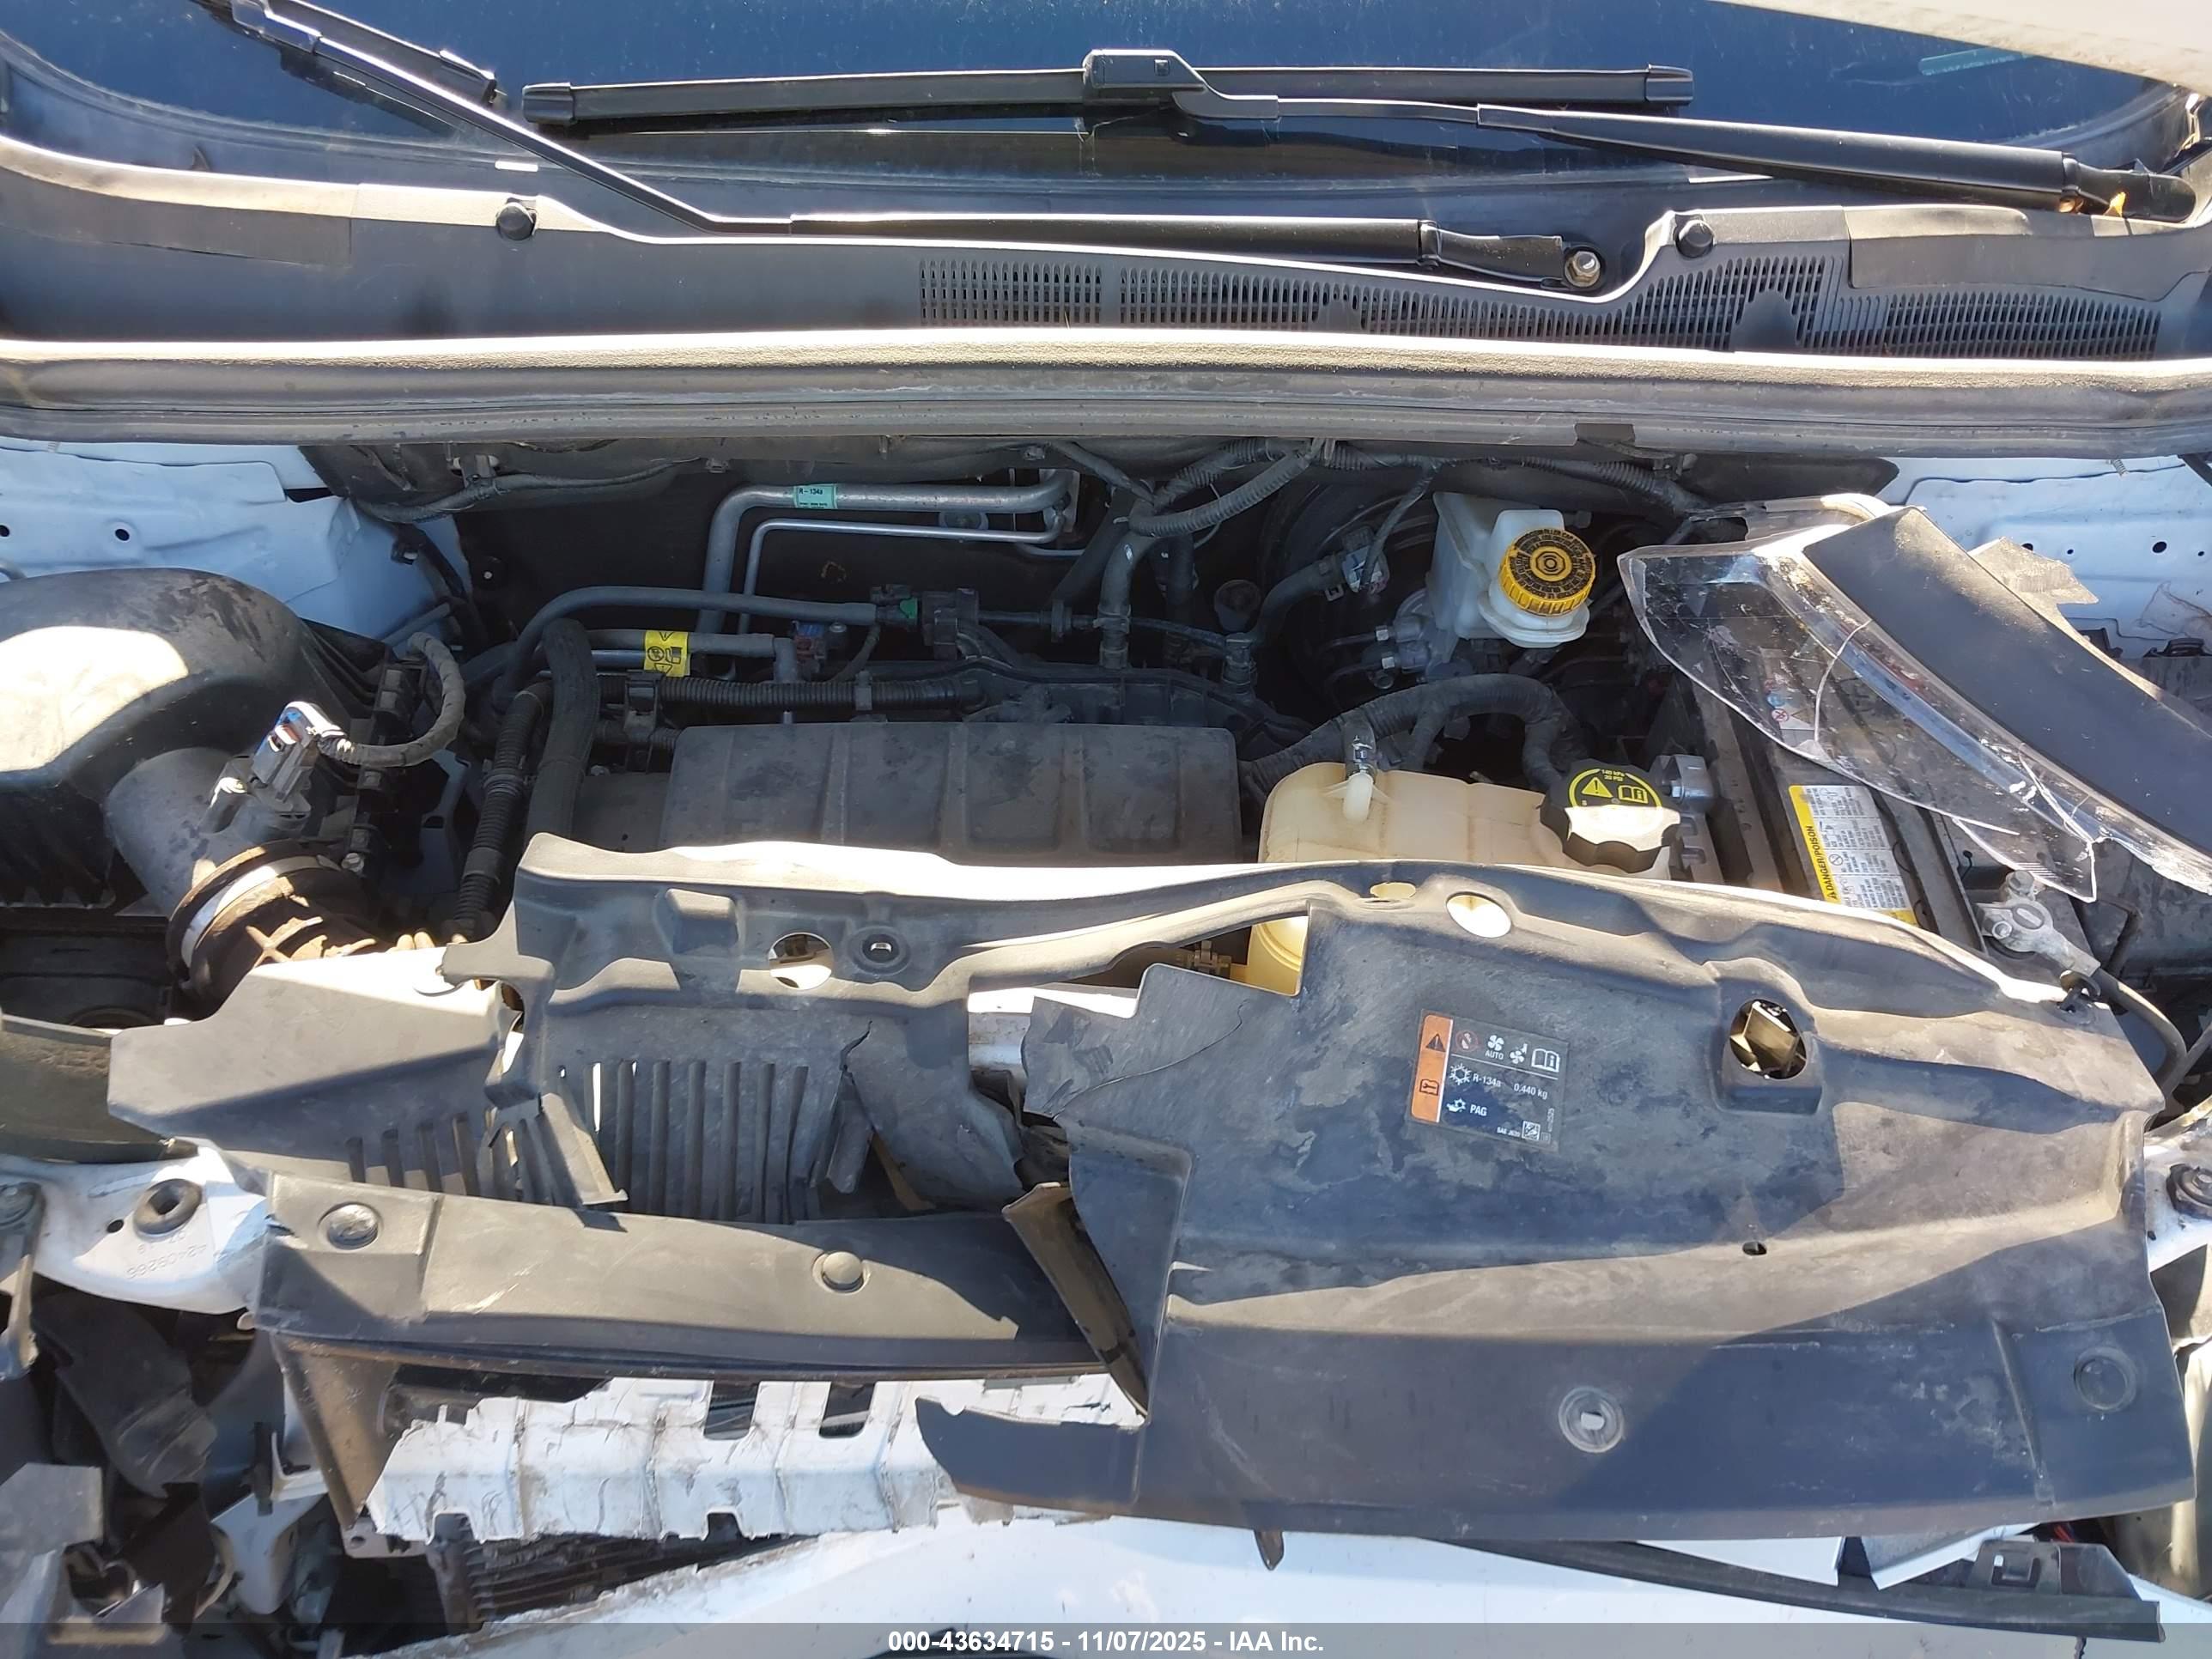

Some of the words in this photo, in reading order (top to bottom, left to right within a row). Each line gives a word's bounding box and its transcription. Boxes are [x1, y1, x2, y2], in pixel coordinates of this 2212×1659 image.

[1805, 825, 1836, 892] DANGER/POISON
[1485, 1049, 1504, 1060] AUTO
[1473, 1073, 1501, 1087] R-134a
[1537, 1089, 1547, 1100] kg
[1470, 1104, 1487, 1116] PAG
